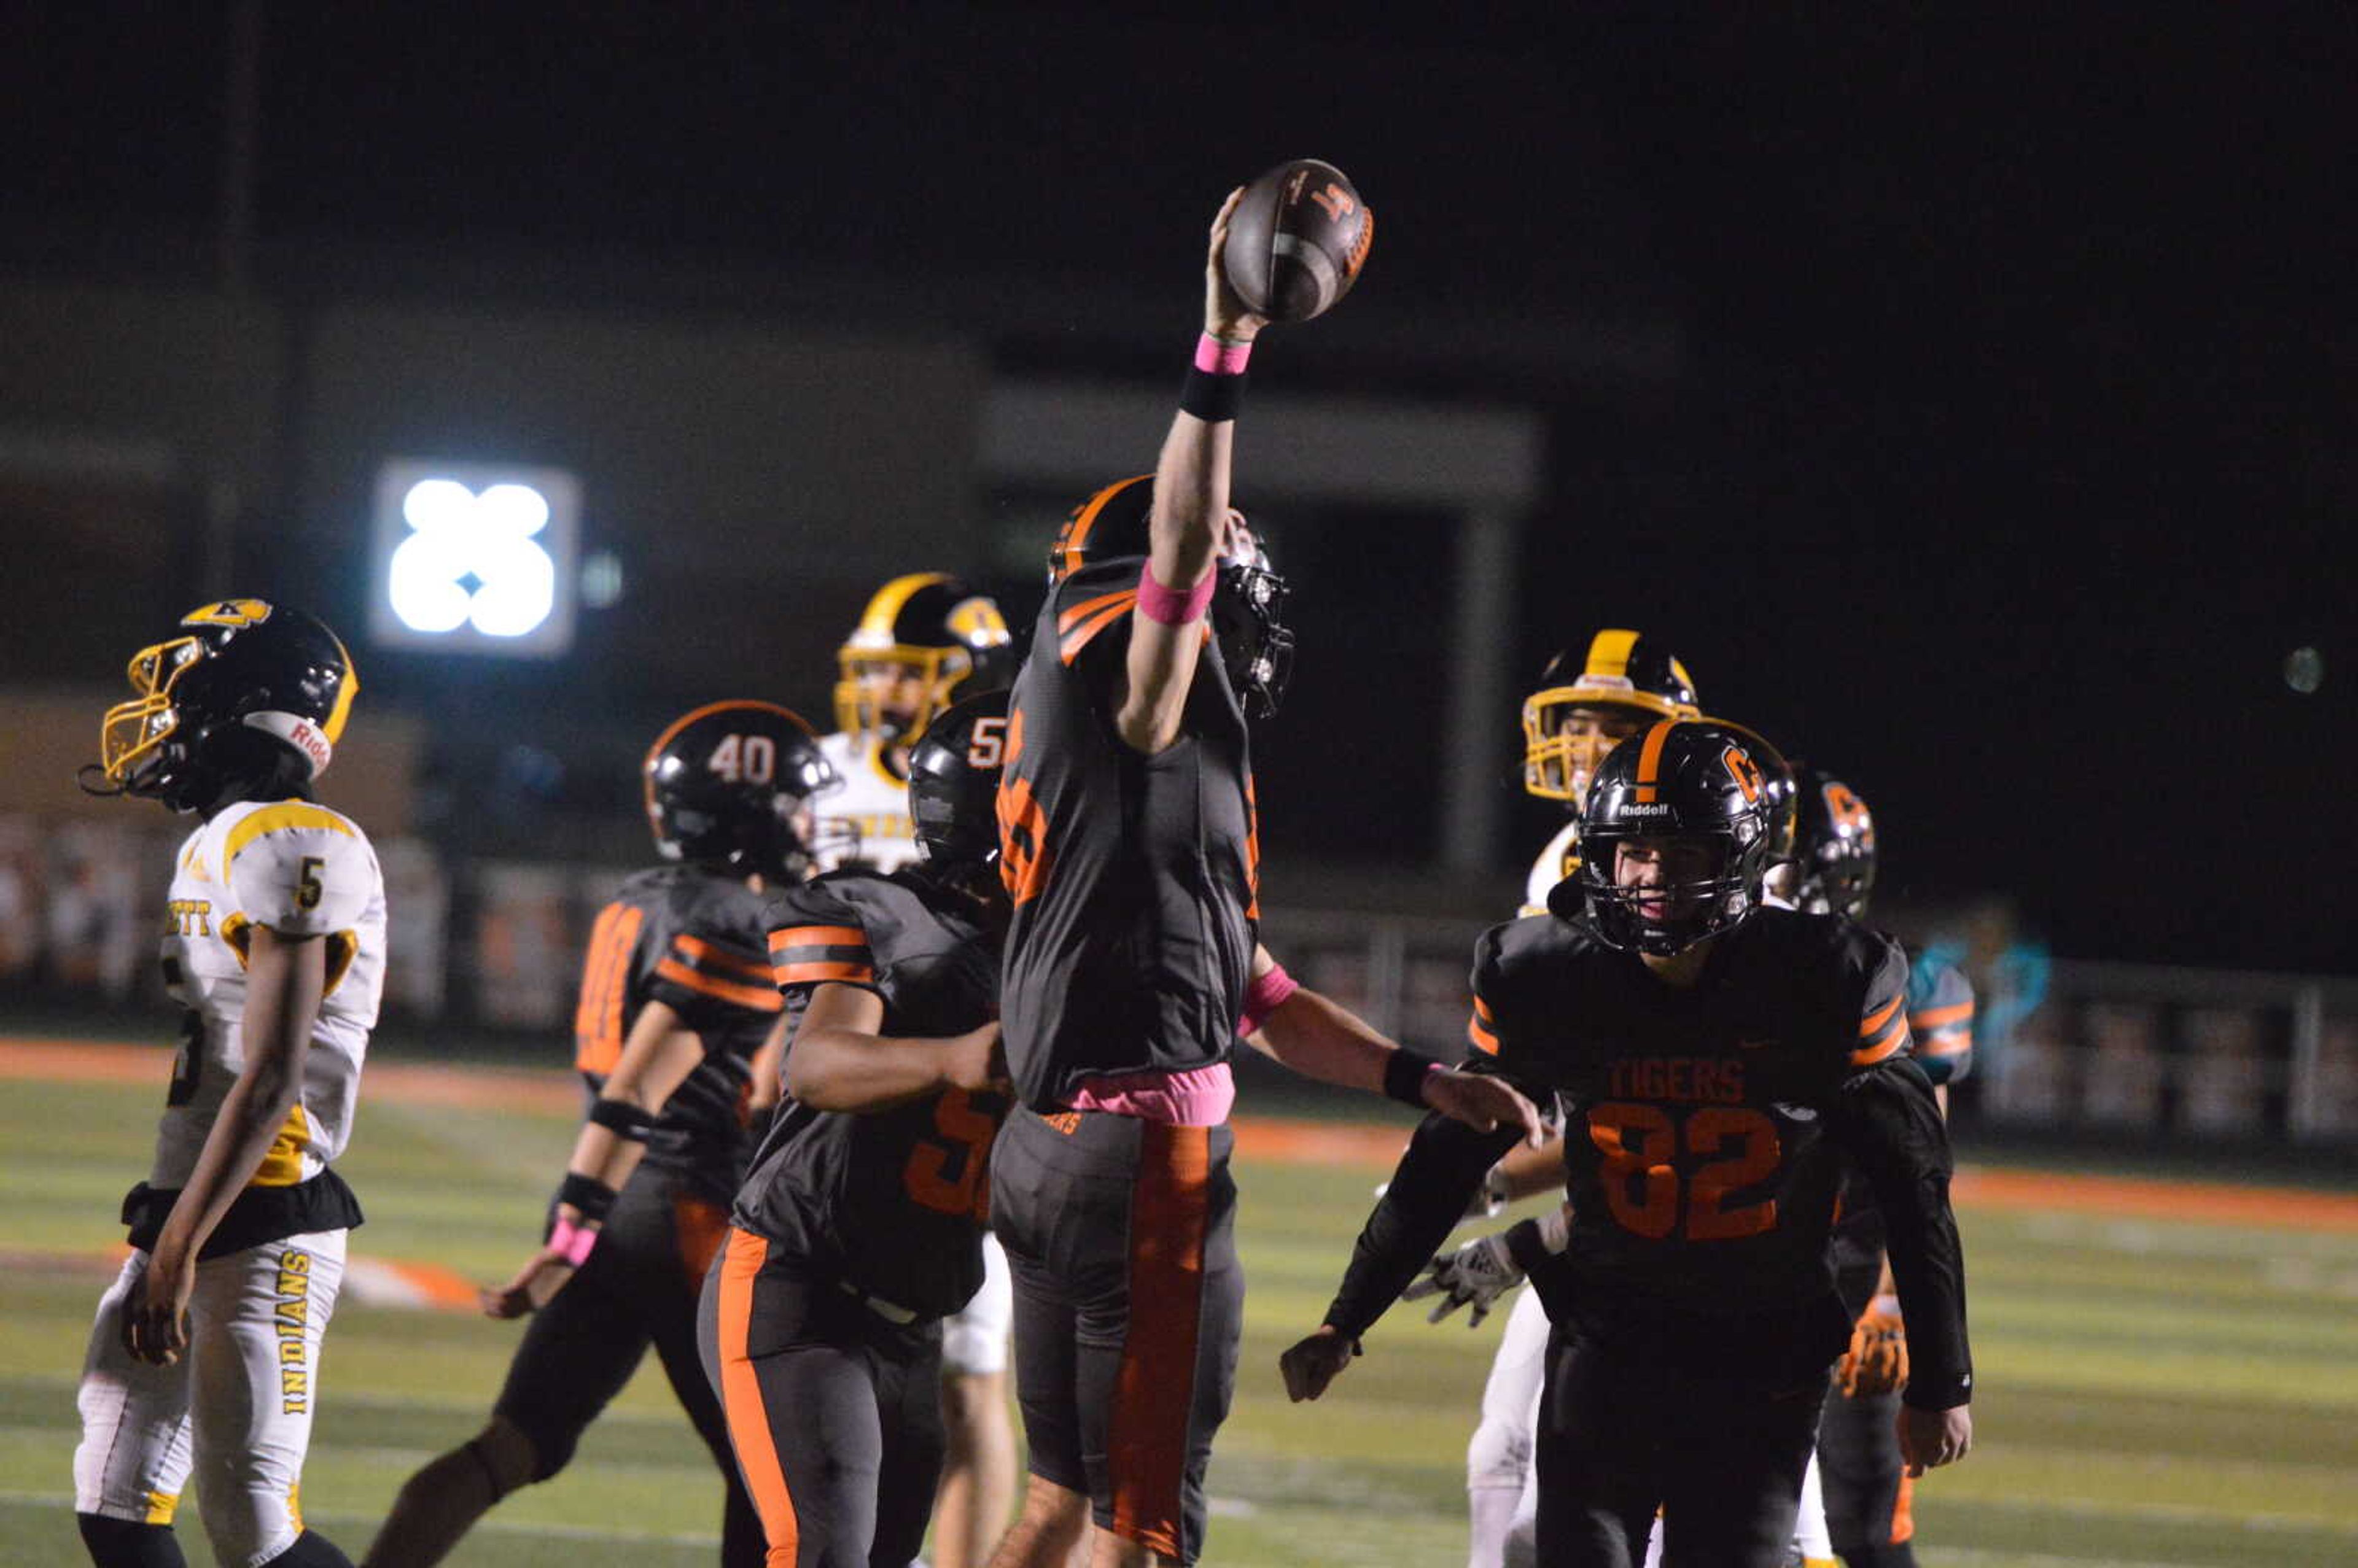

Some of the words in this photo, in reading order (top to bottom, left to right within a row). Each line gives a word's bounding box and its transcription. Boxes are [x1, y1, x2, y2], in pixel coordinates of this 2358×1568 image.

[707, 732, 776, 784] 40
[1619, 803, 1668, 816] Riddell
[294, 855, 325, 910] 5
[1604, 1057, 1746, 1103] TIGERS
[901, 1082, 992, 1223] 5
[1586, 1102, 1781, 1244] 82
[274, 1249, 309, 1415] INDIANS
